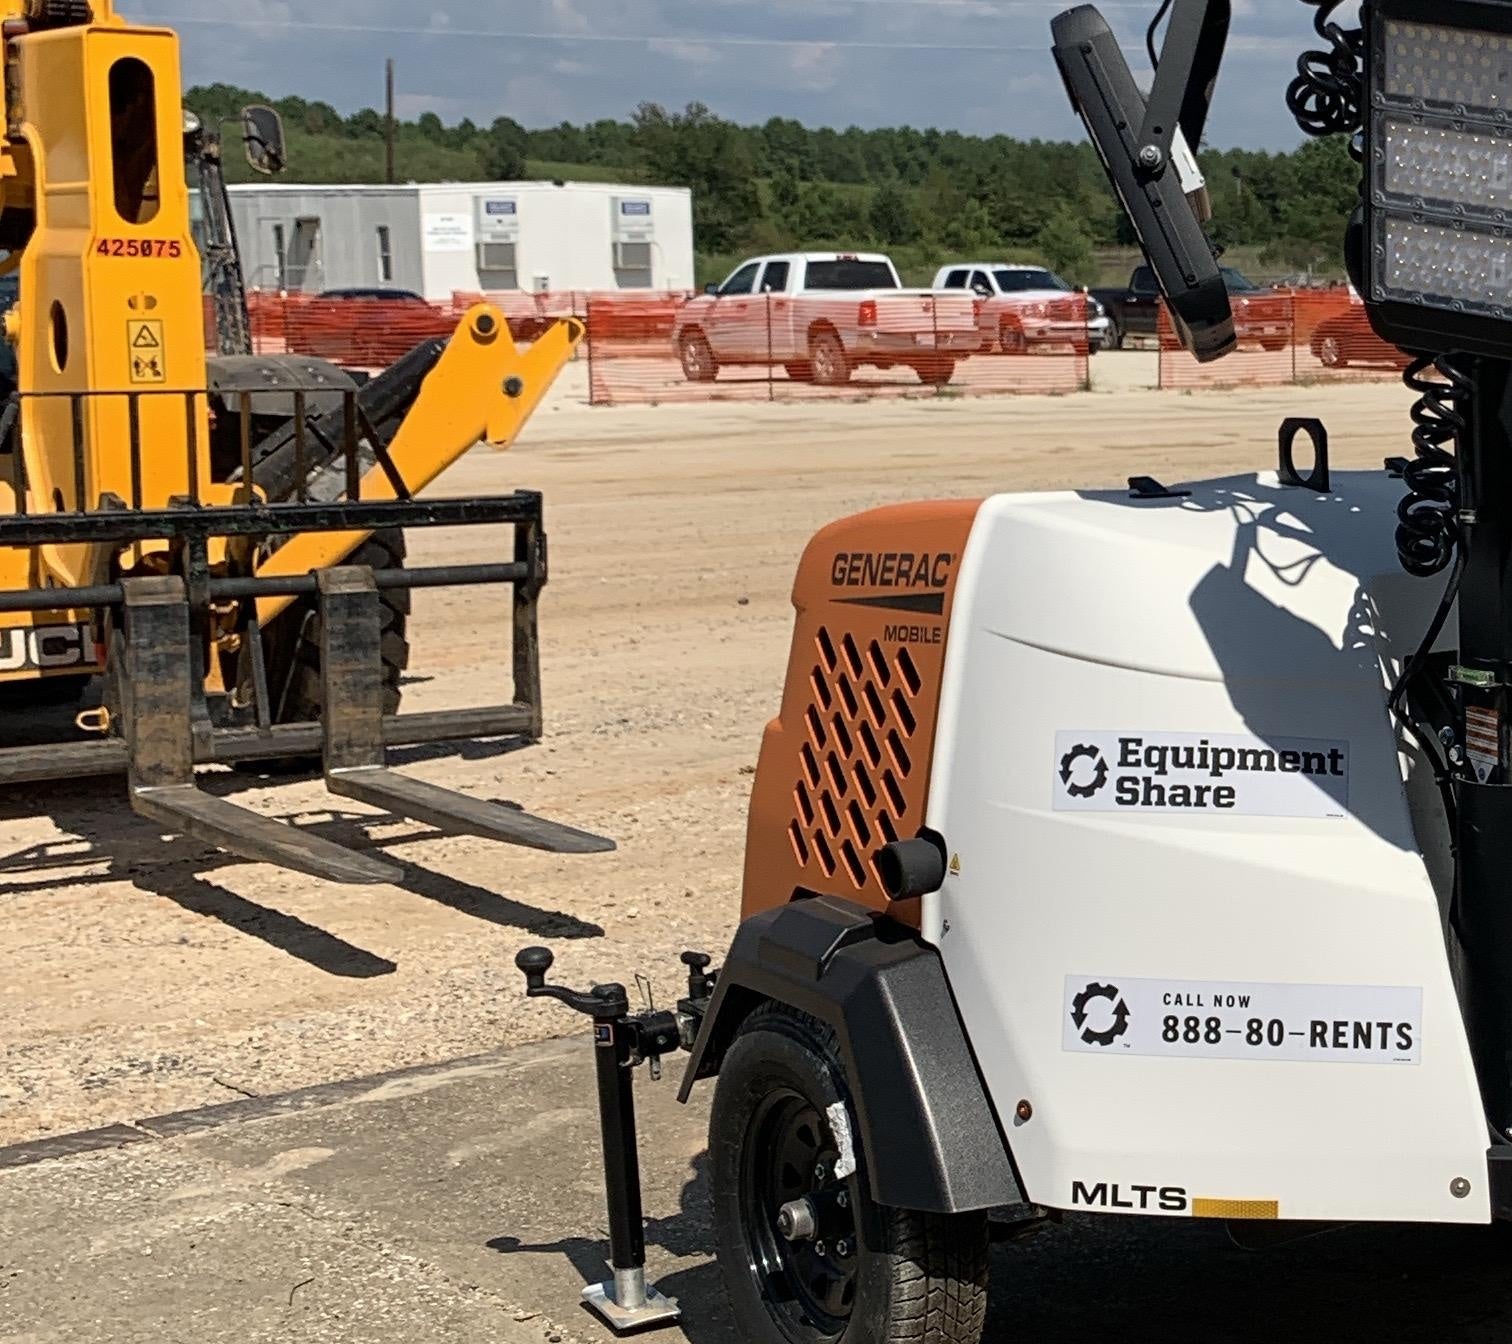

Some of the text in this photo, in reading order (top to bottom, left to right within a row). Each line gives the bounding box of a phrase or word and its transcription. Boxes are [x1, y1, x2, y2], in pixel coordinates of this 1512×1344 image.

[96, 238, 181, 258] 425075
[831, 552, 952, 588] GENERAC
[883, 624, 942, 644] MOBILE
[1117, 737, 1345, 777] Equipment
[1114, 775, 1236, 809] Share
[1162, 992, 1252, 1009] CALL NOW
[1161, 1014, 1414, 1051] 888-80-RENTS
[1071, 1180, 1188, 1212] MLTS
